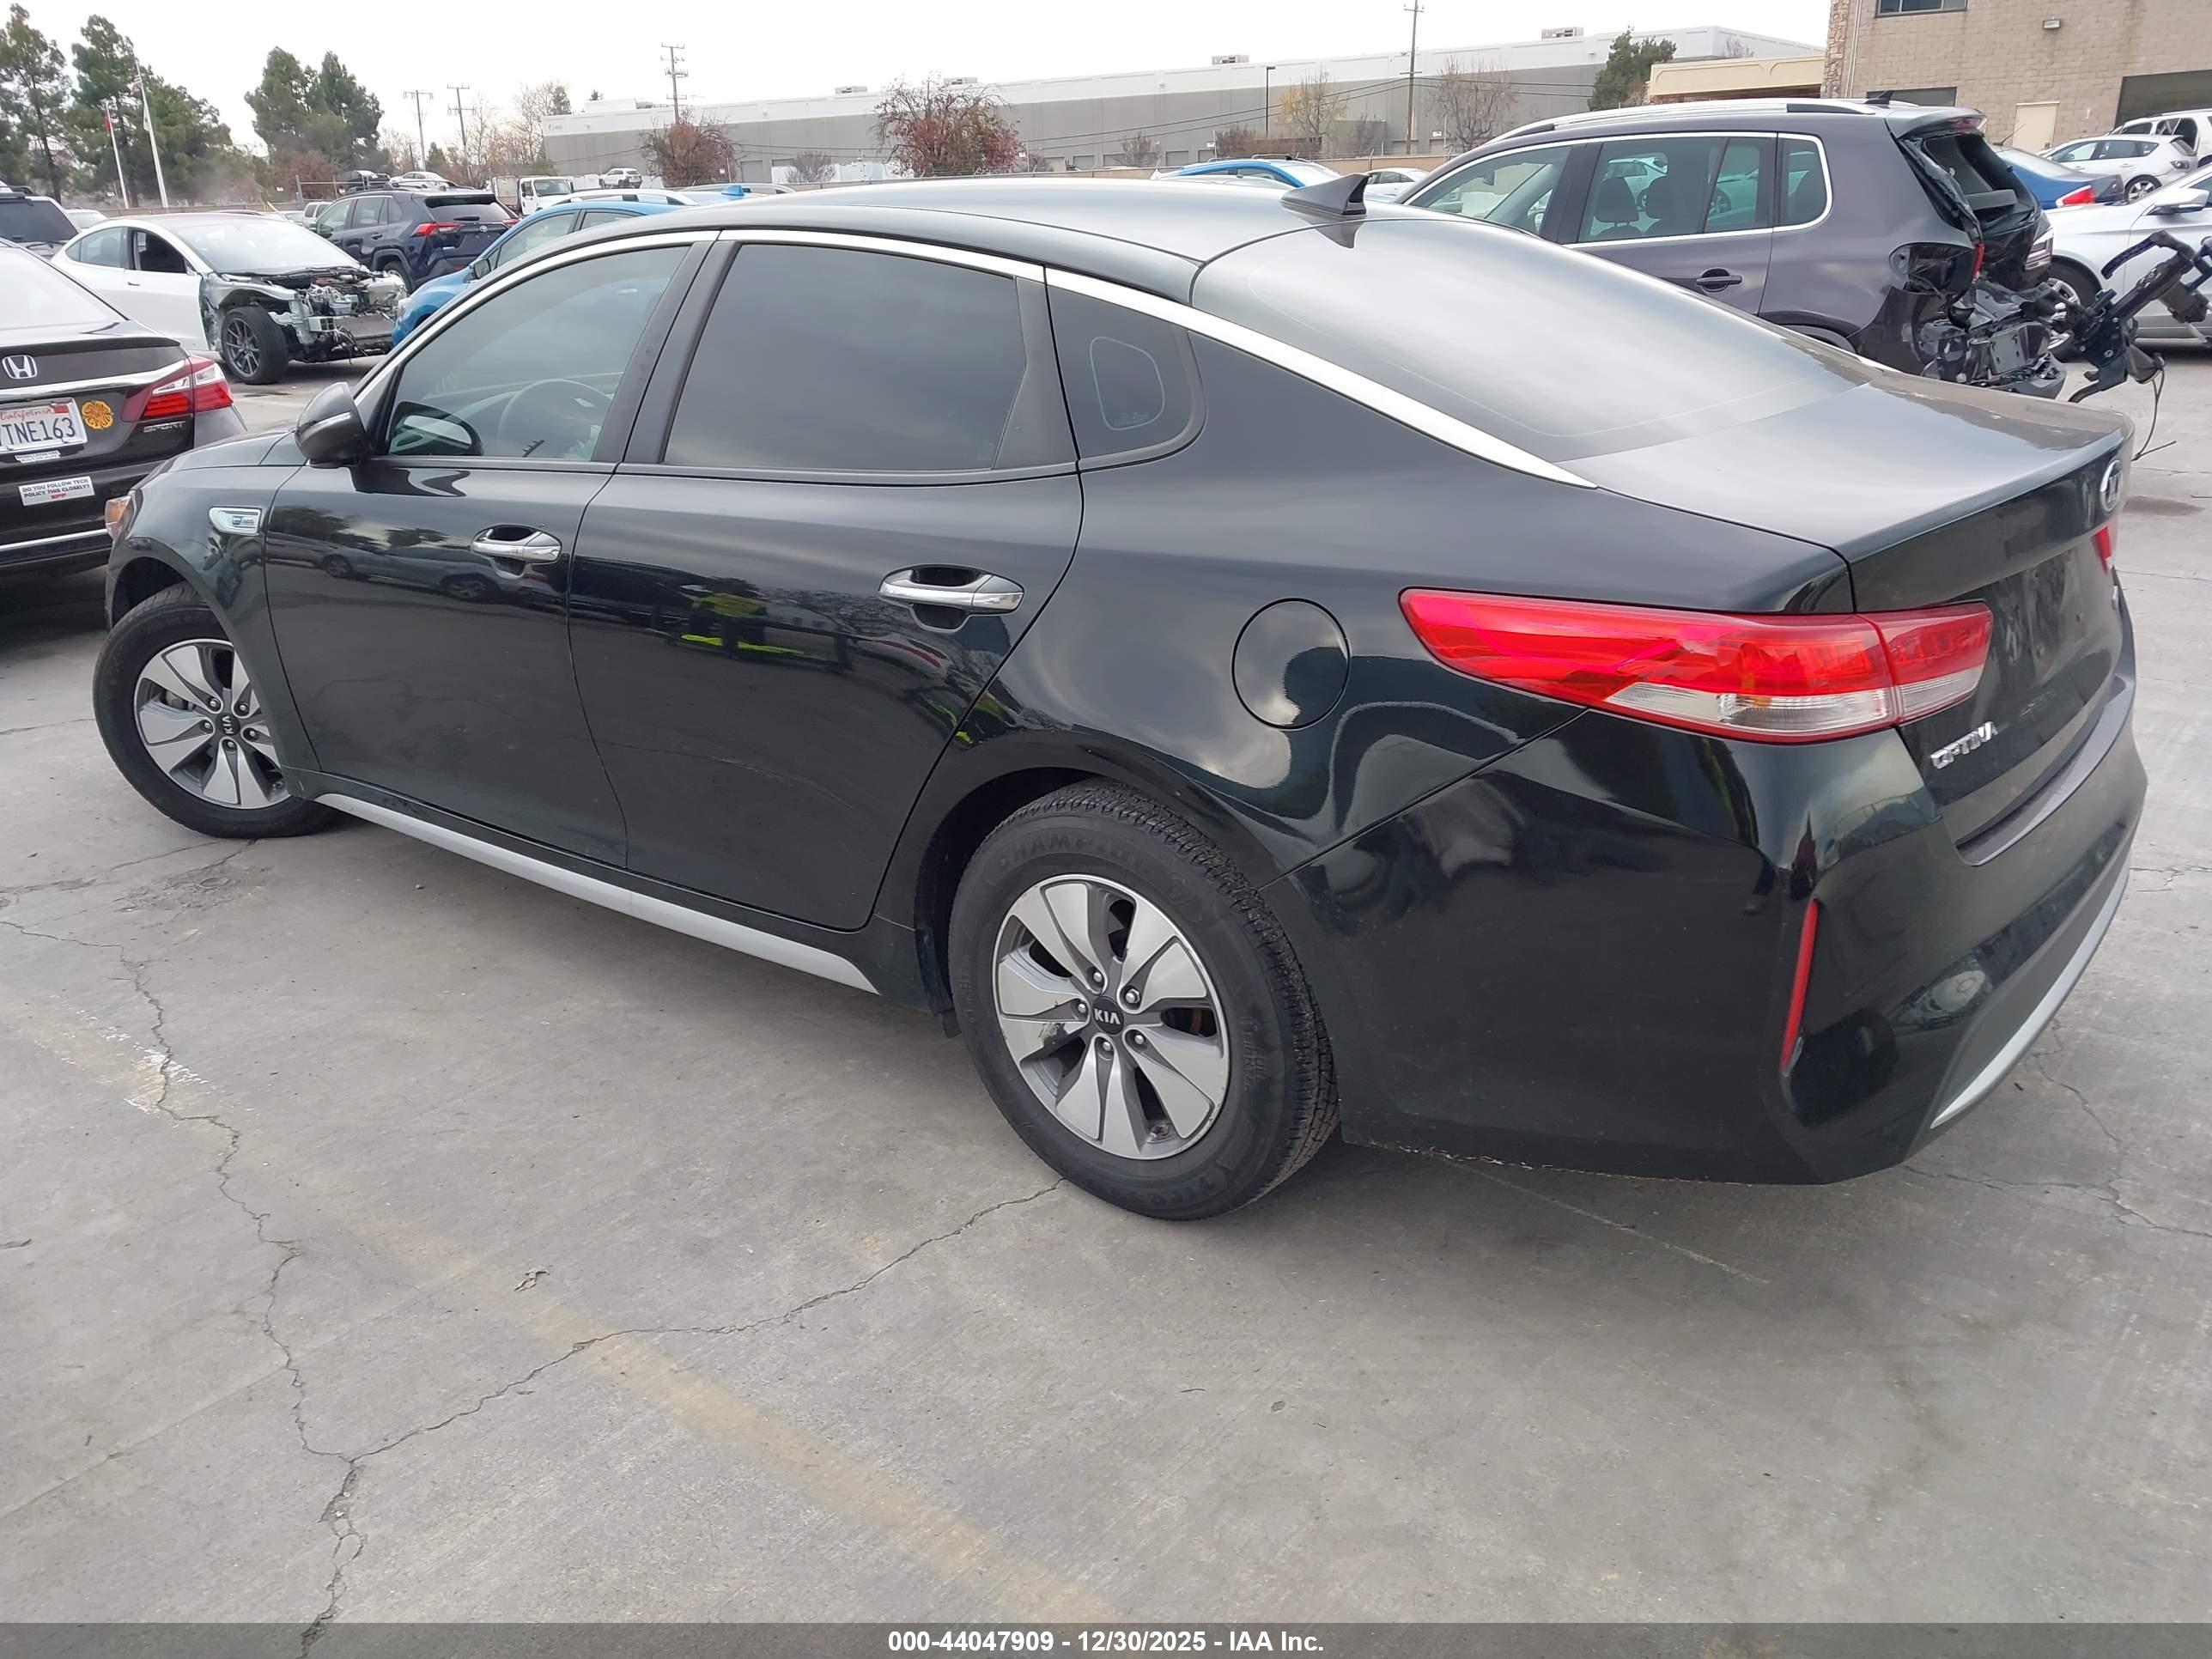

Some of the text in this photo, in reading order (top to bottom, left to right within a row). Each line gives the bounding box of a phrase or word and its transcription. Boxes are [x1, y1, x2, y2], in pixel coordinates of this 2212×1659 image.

[0, 405, 52, 421] California
[0, 416, 76, 446] TNE163
[46, 481, 72, 489] FOLLOW
[61, 483, 90, 492] CLOSELY?
[1094, 1008, 1121, 1025] KIA
